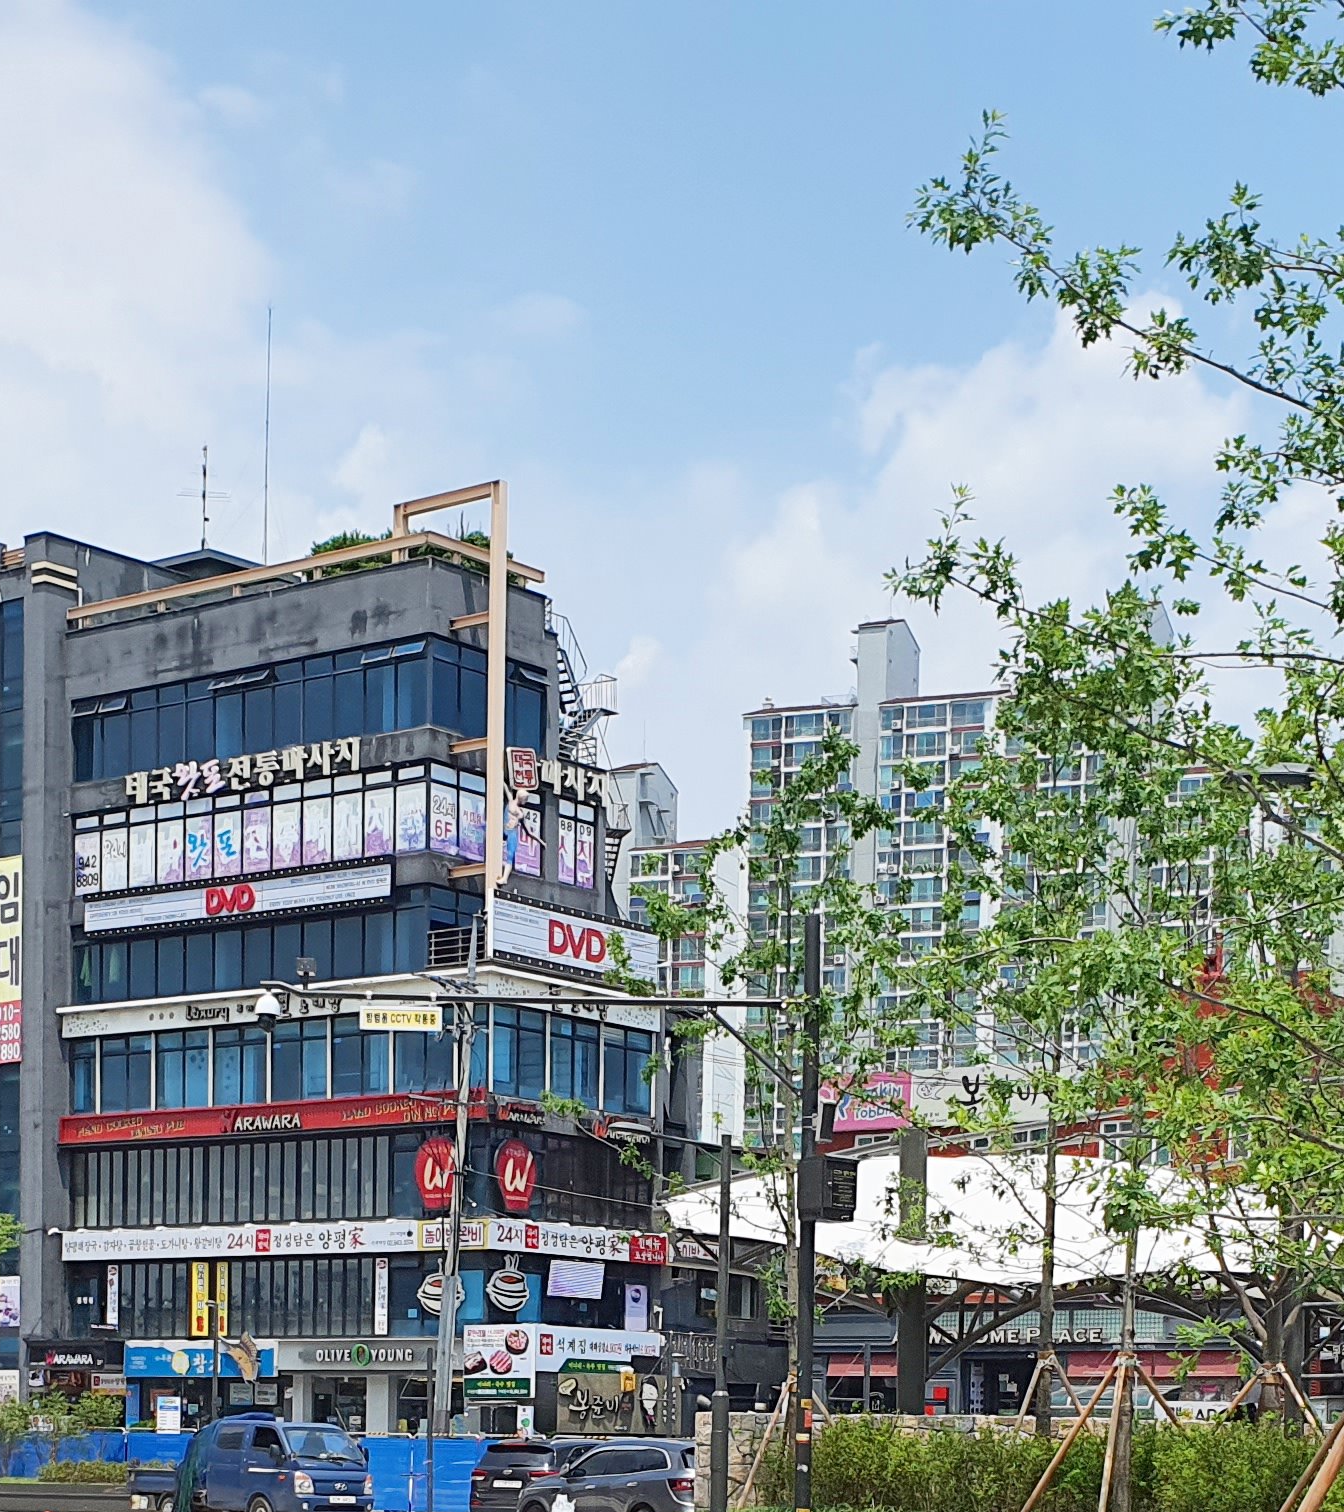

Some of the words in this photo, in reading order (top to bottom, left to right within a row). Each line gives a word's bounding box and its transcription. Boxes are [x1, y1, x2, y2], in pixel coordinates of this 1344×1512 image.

[227, 736, 362, 791] 전통마사지
[540, 759, 607, 808] 마사지
[434, 820, 453, 839] 6F
[205, 883, 256, 916] DVD
[548, 918, 606, 964] DVD
[185, 1005, 231, 1023] Luxury
[390, 1012, 412, 1025] CCTV
[413, 1012, 437, 1026] 작동중
[220, 1109, 301, 1134] WARAWARA
[226, 1232, 254, 1250] 24시
[272, 1233, 315, 1248] 정성담은
[497, 1225, 523, 1243] 24시
[1027, 1327, 1103, 1344] PACE
[44, 1350, 94, 1366] WARAWARA
[315, 1349, 351, 1362] OLIVE
[370, 1348, 414, 1362] YOUNG
